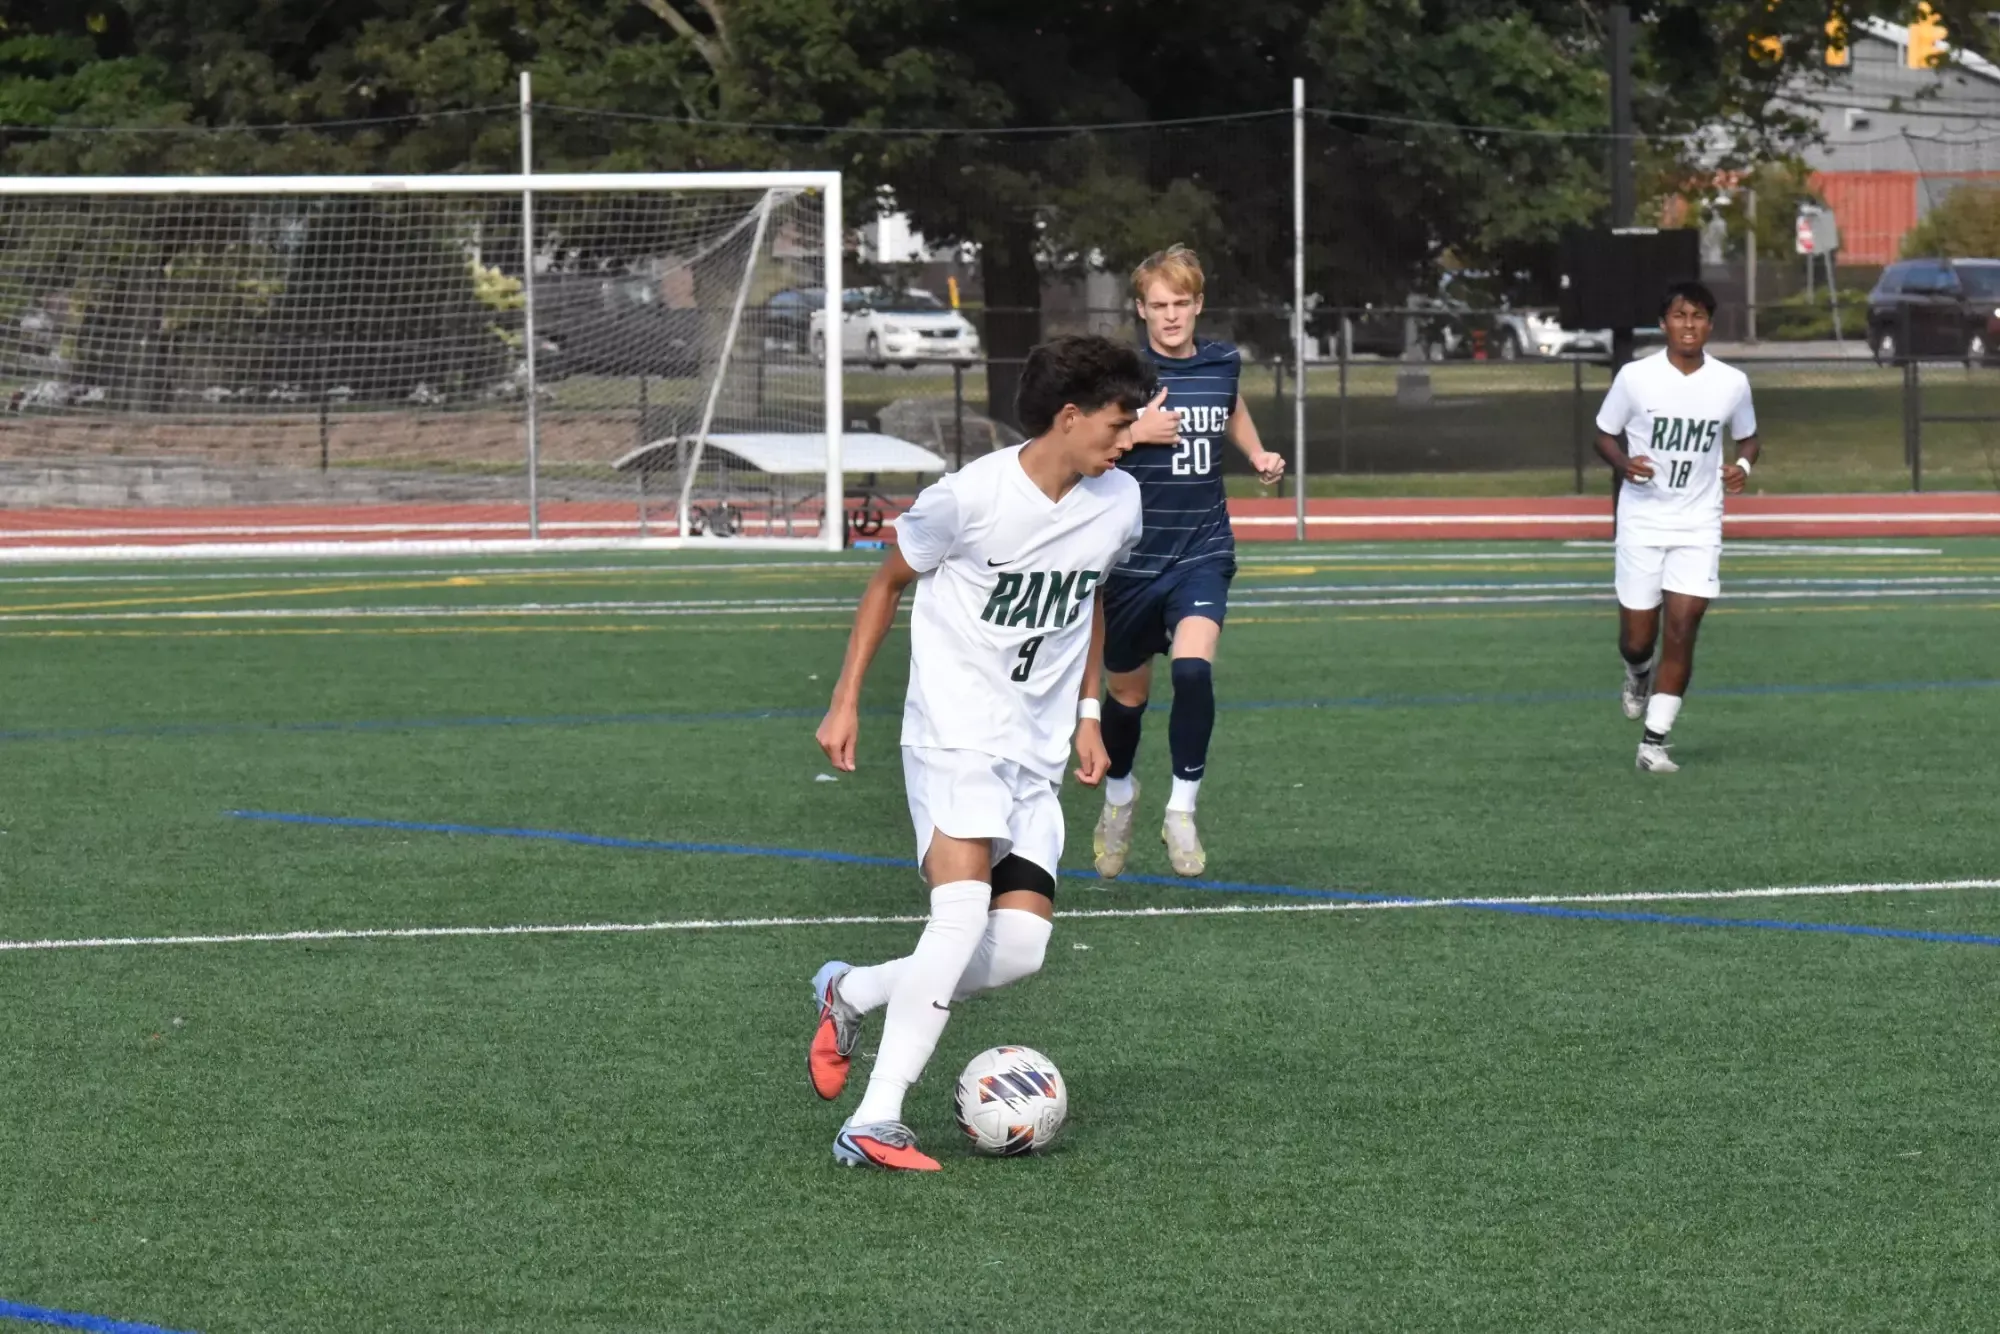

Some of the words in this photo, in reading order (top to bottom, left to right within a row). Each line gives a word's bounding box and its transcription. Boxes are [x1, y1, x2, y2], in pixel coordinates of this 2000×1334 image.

[1136, 406, 1229, 433] RUC
[1651, 416, 1720, 453] RAMS
[1172, 438, 1211, 475] 20
[1668, 459, 1693, 488] 18
[1011, 635, 1044, 682] 9
